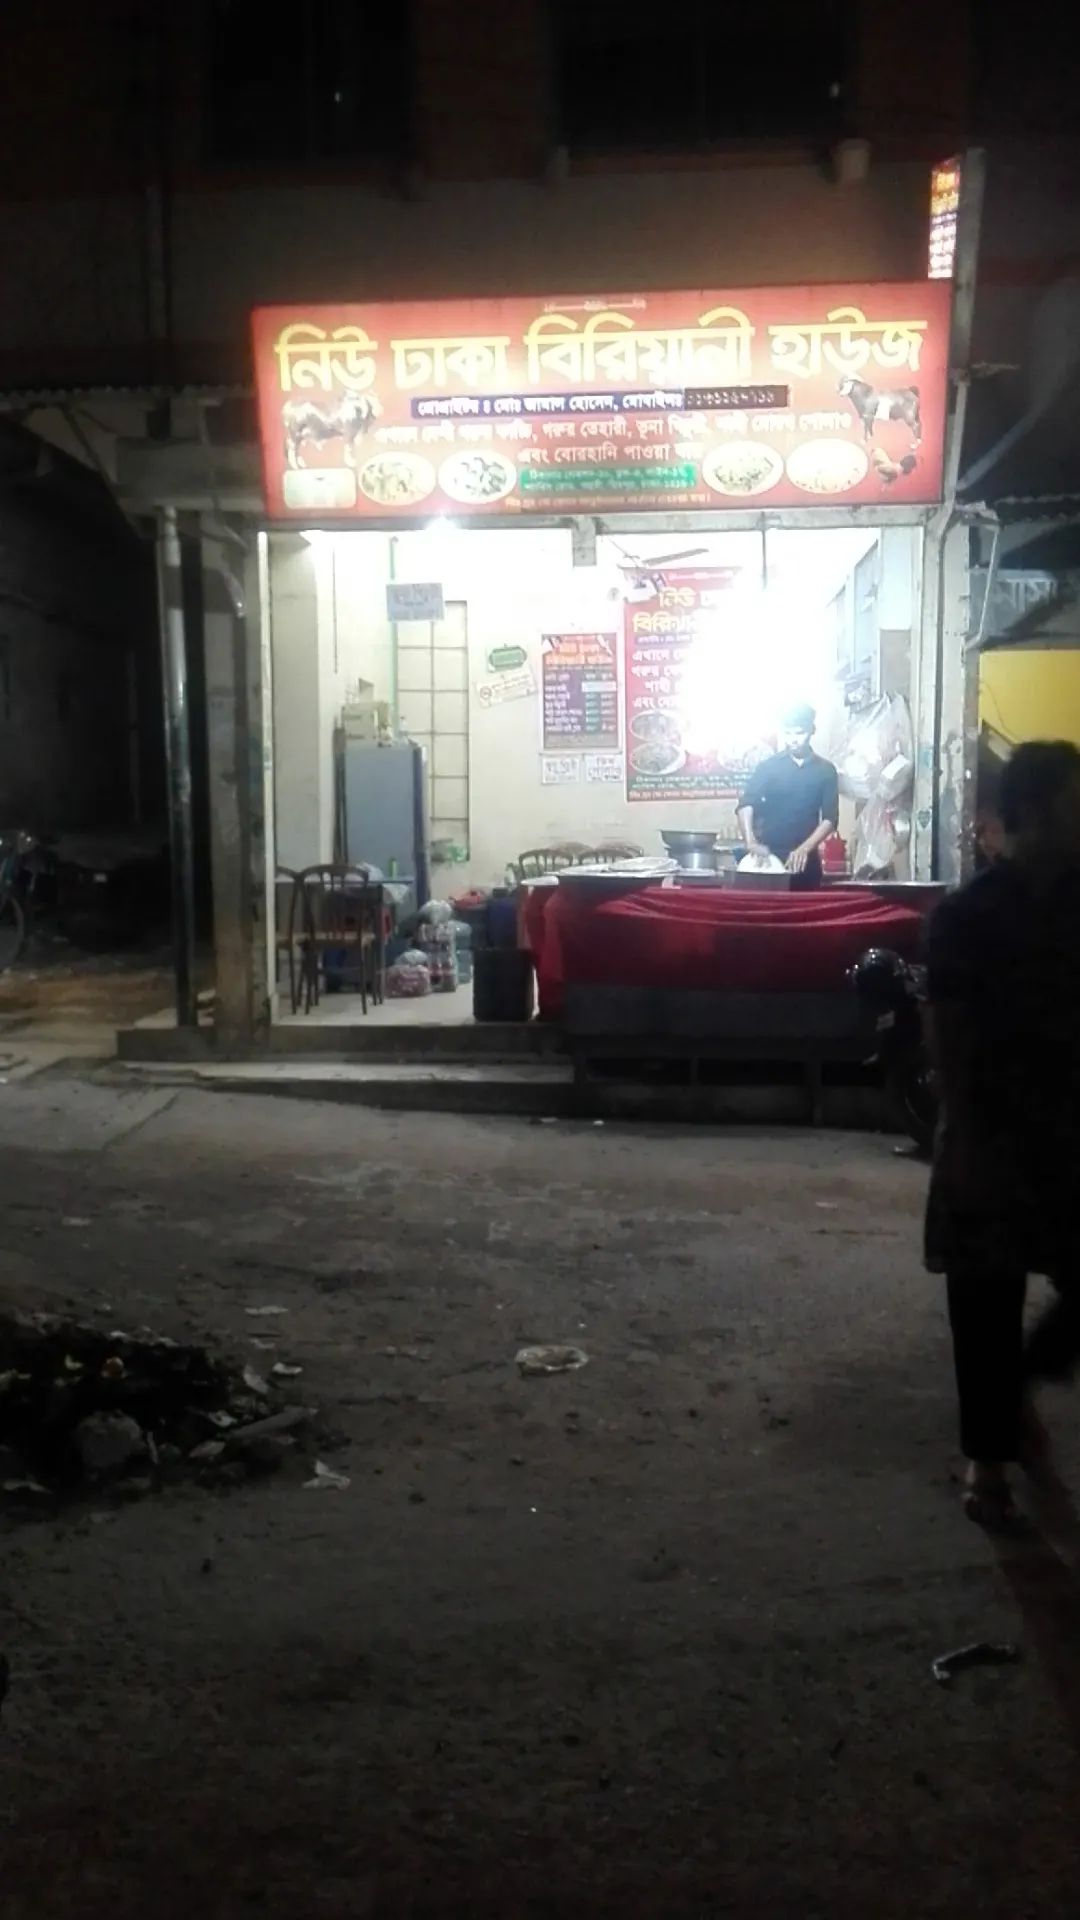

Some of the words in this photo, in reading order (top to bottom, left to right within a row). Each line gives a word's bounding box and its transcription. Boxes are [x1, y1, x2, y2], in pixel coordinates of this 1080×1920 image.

[274, 324, 378, 391] নিউ
[391, 336, 510, 389] ঢাকা
[522, 306, 756, 387] বিরিয়ানী
[768, 306, 927, 379] হাউজ
[517, 447, 550, 463] এবং
